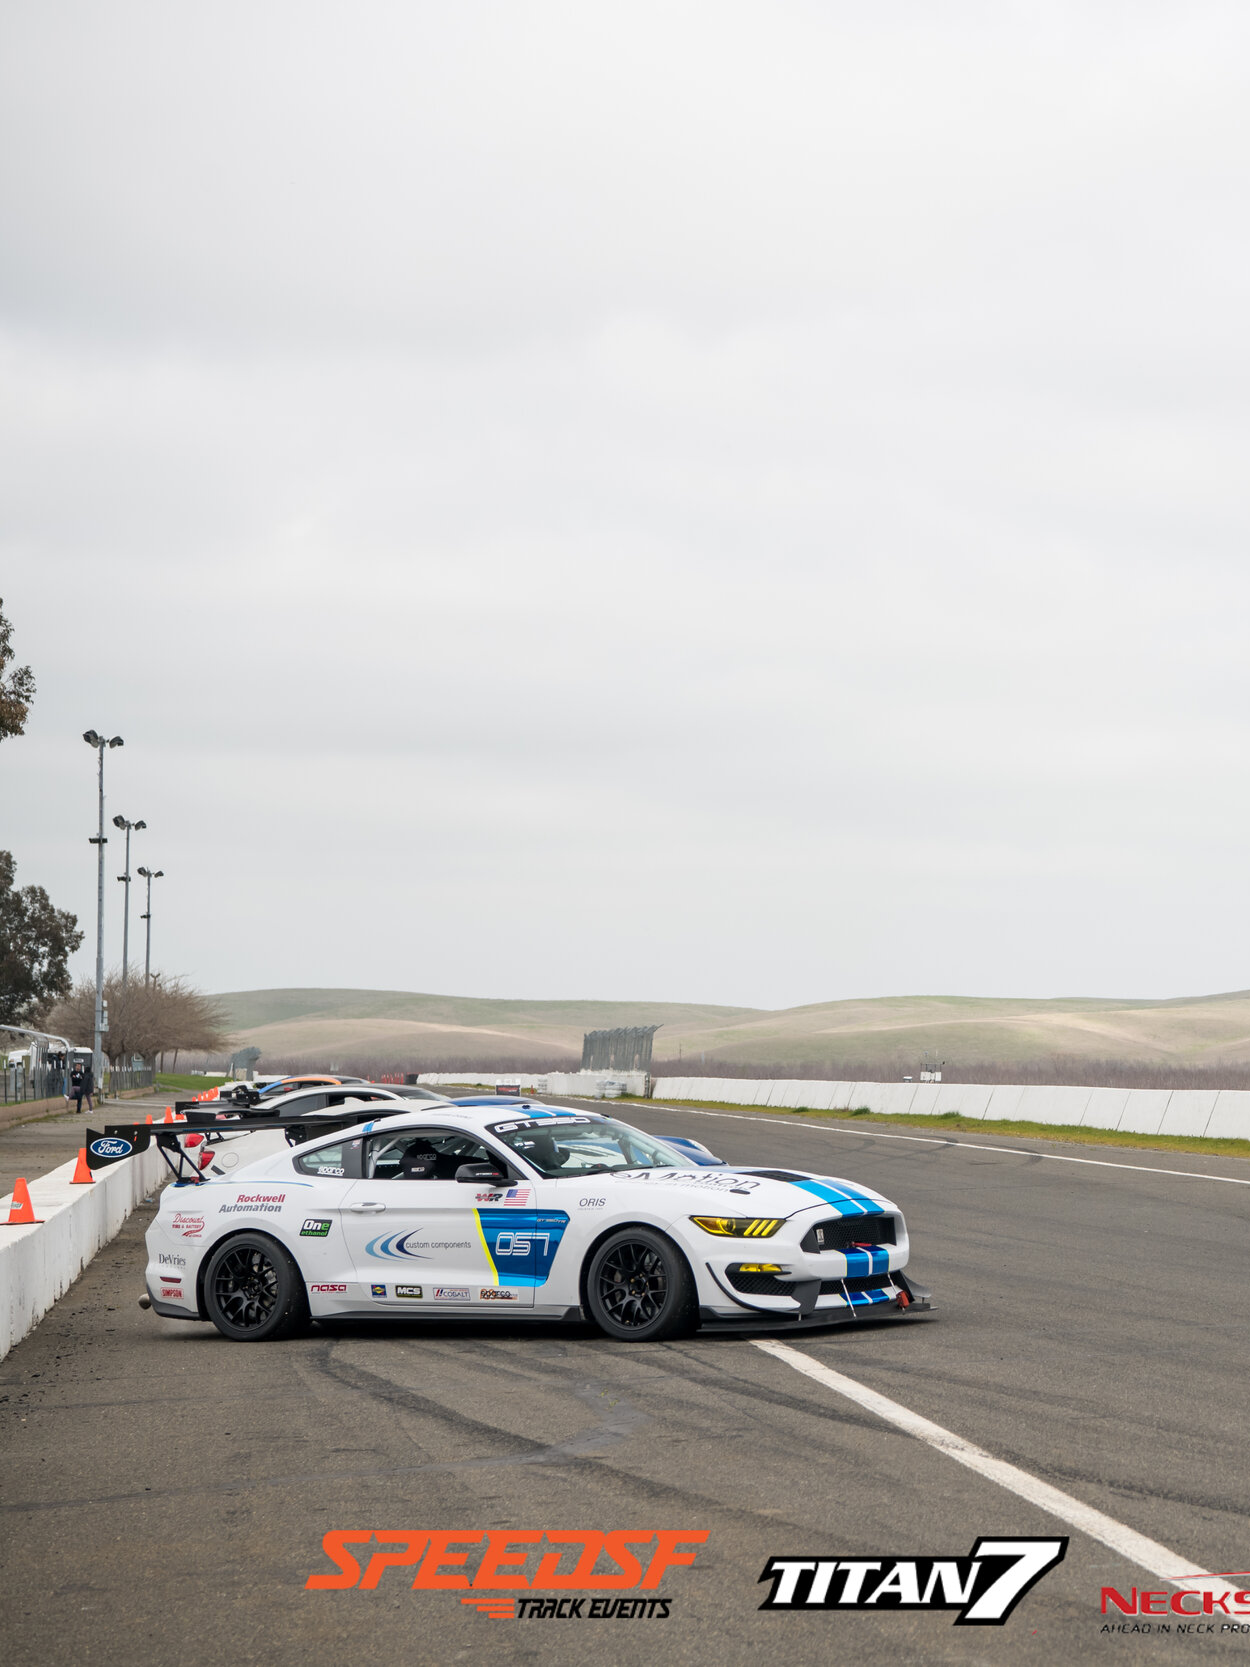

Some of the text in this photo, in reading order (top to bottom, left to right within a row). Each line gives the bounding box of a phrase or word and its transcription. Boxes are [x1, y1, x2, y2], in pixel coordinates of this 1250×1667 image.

[98, 1140, 124, 1154] Ford
[236, 1194, 286, 1203] Rockwell
[578, 1197, 606, 1207] ORIS
[218, 1203, 282, 1213] Automation
[303, 1219, 330, 1231] One
[405, 1241, 471, 1250] custom components
[495, 1232, 550, 1256] 057
[158, 1253, 187, 1266] DeVries
[162, 1288, 183, 1298] SIMPSON
[397, 1286, 421, 1295] MCS
